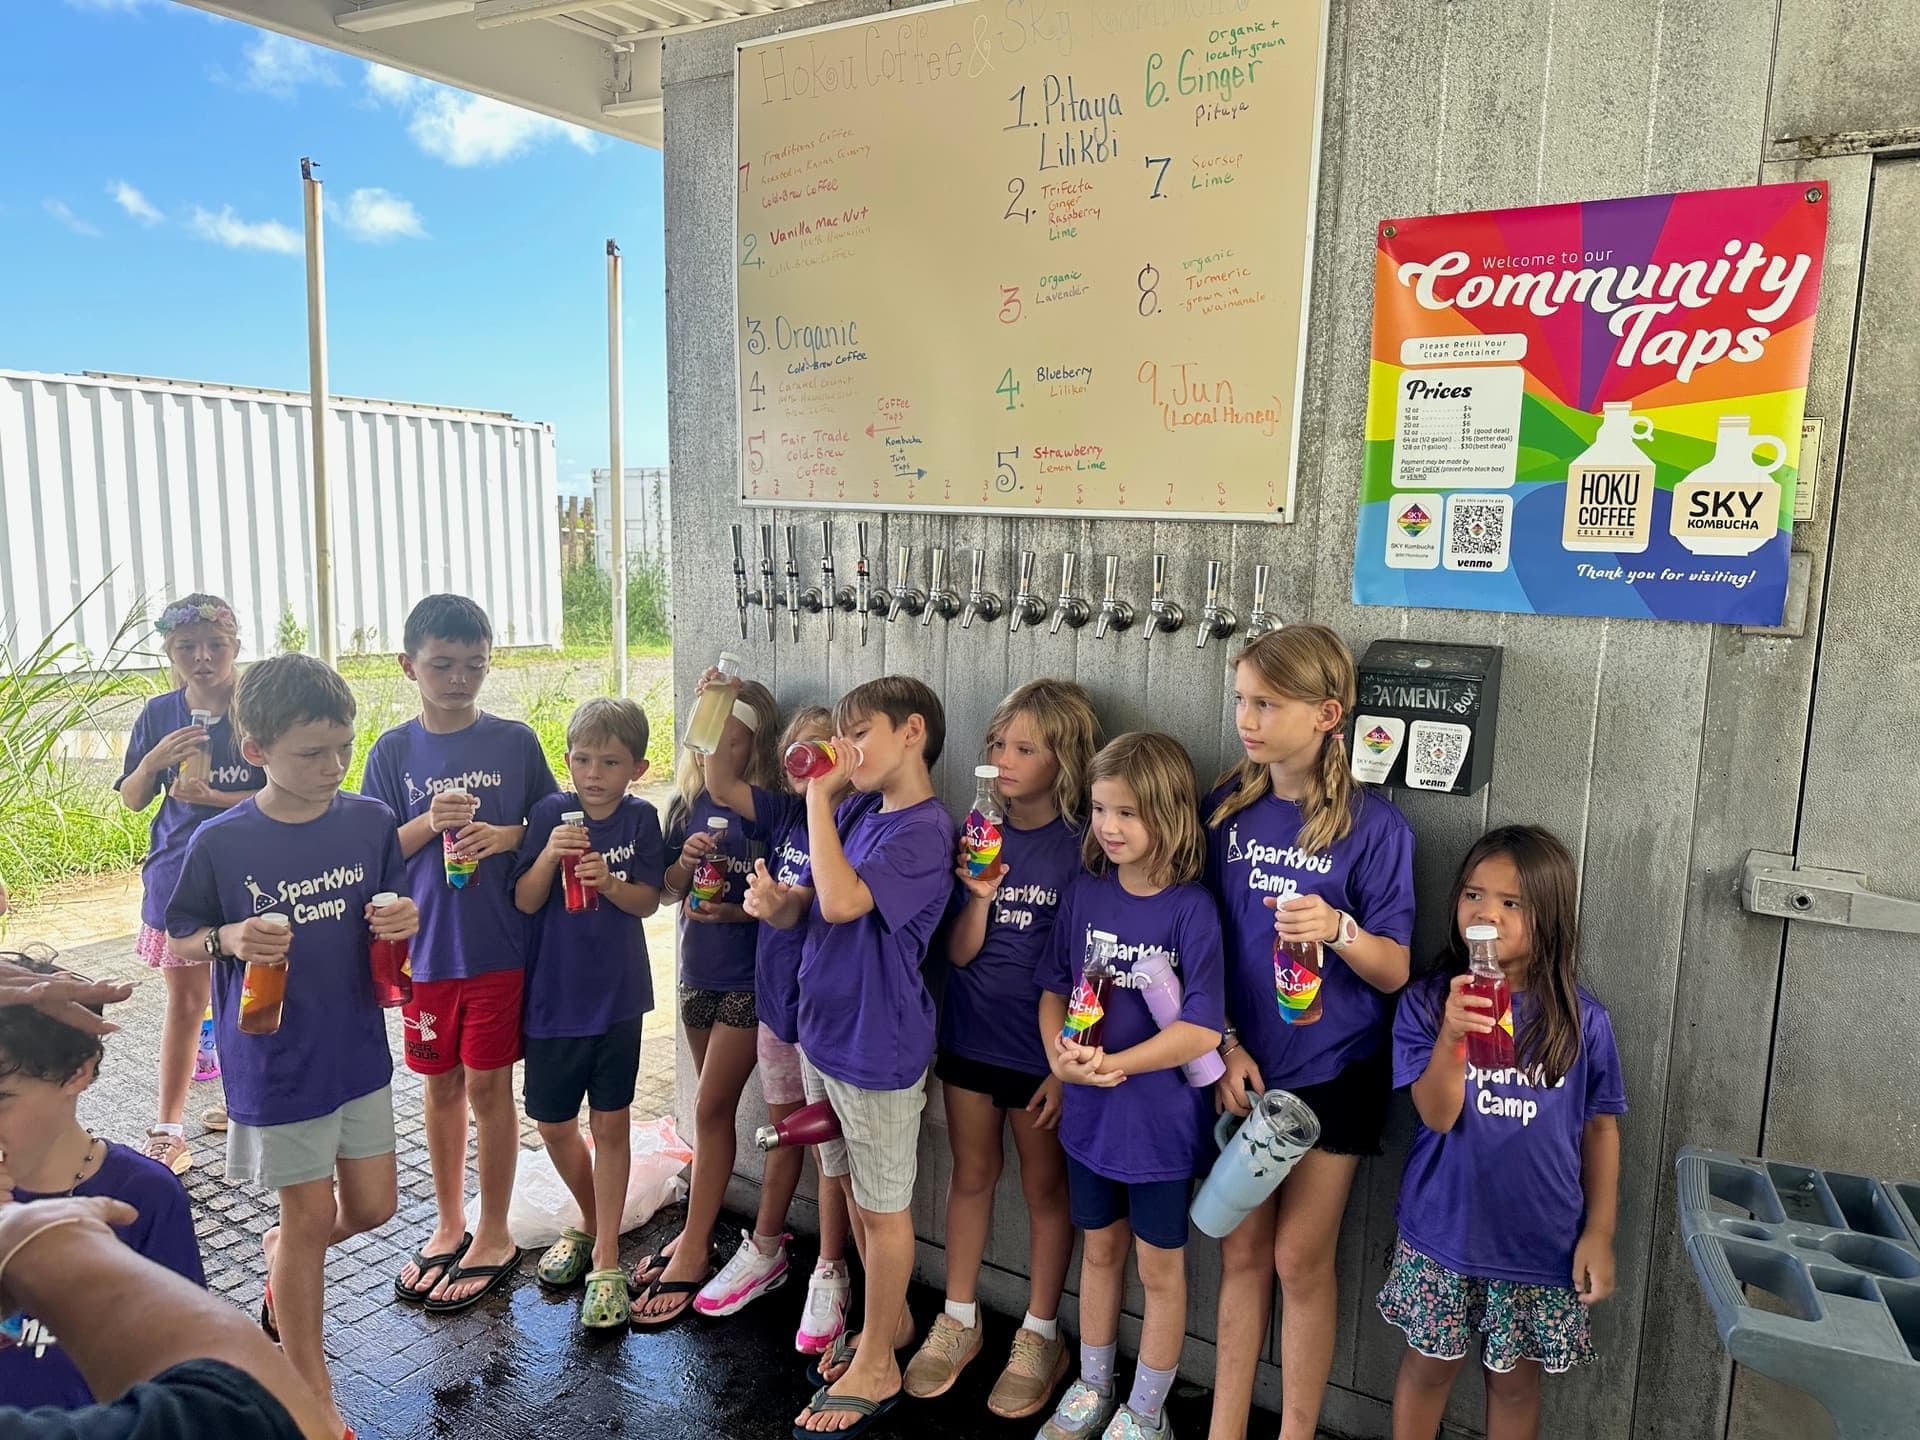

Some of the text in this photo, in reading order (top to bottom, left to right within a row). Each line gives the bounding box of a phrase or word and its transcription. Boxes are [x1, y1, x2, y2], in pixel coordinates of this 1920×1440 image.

[1178, 48, 1263, 102] Ginger
[1043, 74, 1122, 145] Pitaya
[770, 221, 812, 246] Vanilla
[843, 206, 869, 223] Nut
[1483, 248, 1615, 270] Welcome to our
[1185, 268, 1252, 291] Turmeric
[1397, 239, 1811, 324] Community
[775, 315, 859, 367] Organic
[1419, 340, 1508, 351] Please Refill Your
[1608, 301, 1772, 384] Taps
[1423, 349, 1501, 359] Clean Container
[1036, 366, 1093, 384] Blueberry
[1169, 362, 1234, 406] Jun
[1406, 379, 1473, 401] Prices
[1033, 445, 1104, 460] Strawberry
[1580, 473, 1640, 506] HOKU
[1688, 490, 1763, 517] SKY
[1578, 507, 1636, 527] COFFEE
[1687, 519, 1759, 530] KOMBUCHA
[1608, 529, 1634, 537] BREW
[1457, 559, 1493, 568] venmo
[1577, 563, 1757, 588] Thank you for visiting!
[1371, 684, 1450, 710] PAYMENT
[294, 899, 346, 924] Camp
[1477, 1089, 1537, 1126] Camp
